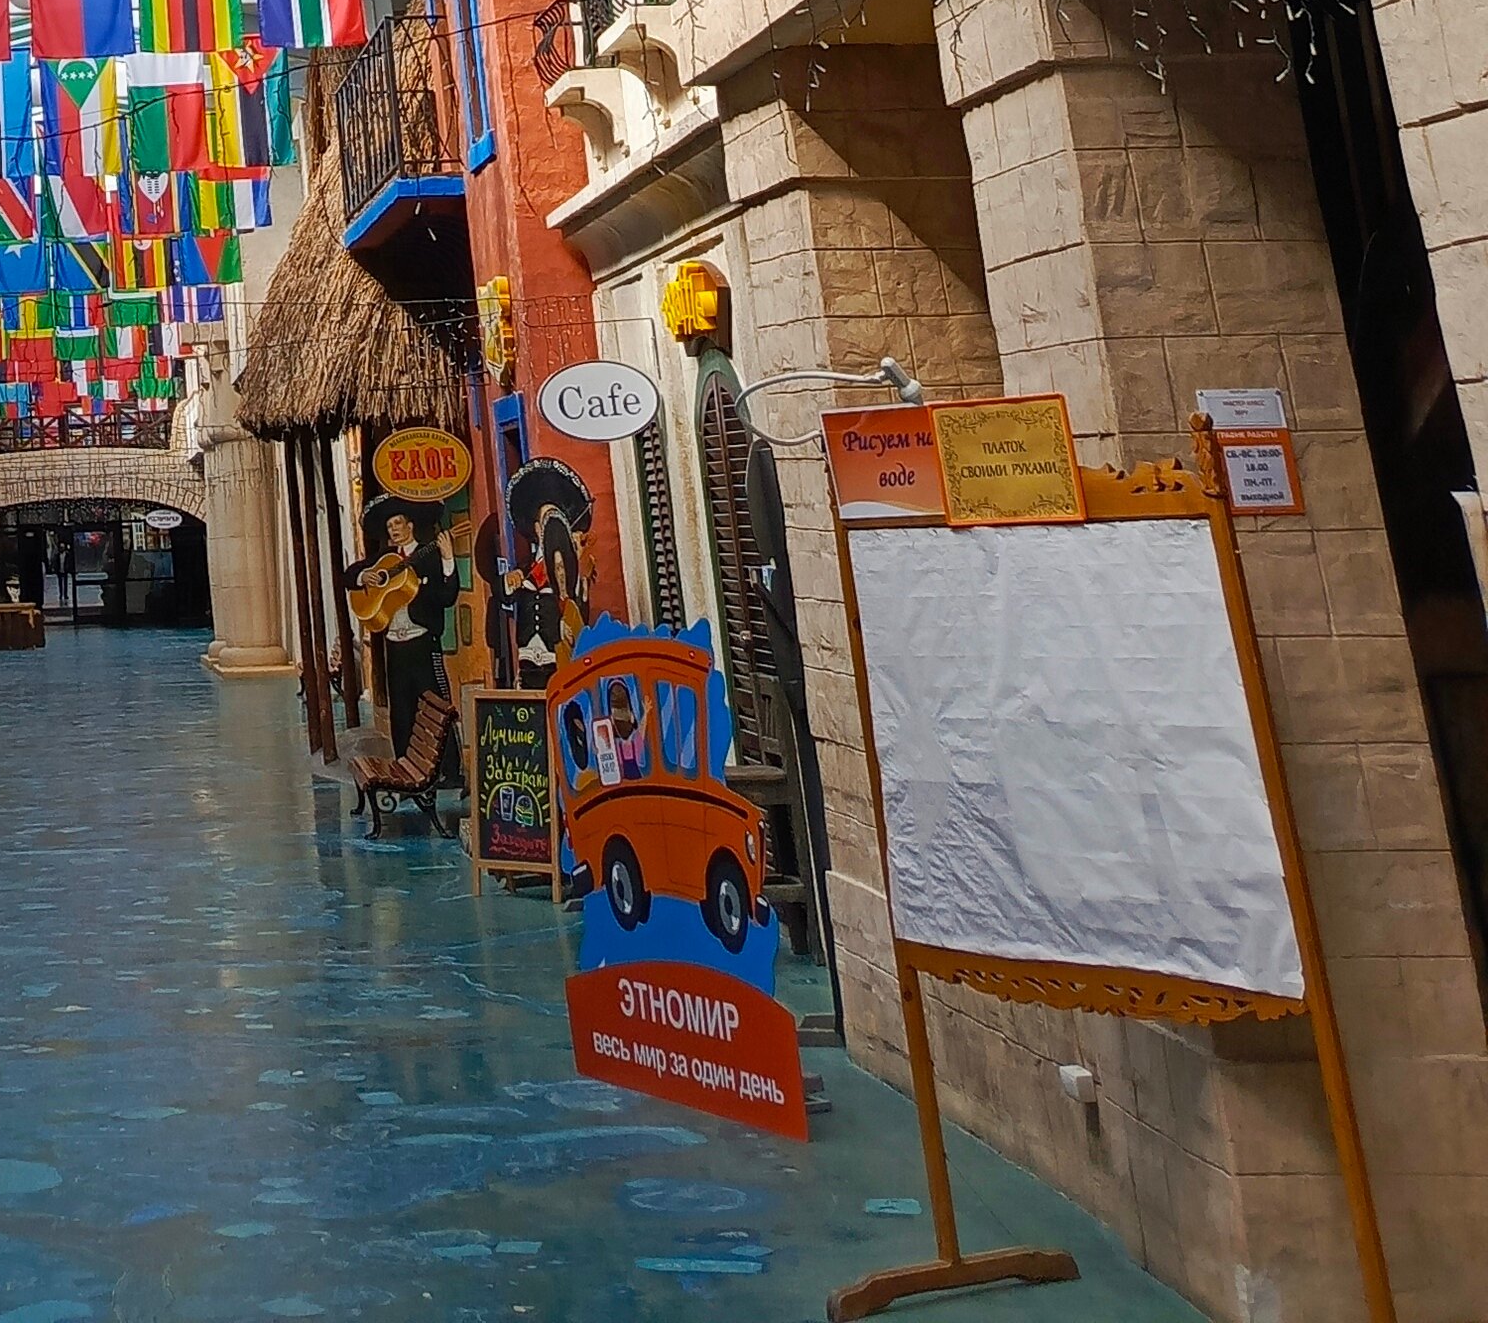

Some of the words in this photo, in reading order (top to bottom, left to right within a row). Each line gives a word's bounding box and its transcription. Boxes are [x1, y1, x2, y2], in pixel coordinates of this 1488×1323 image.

[558, 383, 642, 420] Cafe
[842, 431, 910, 458] Рисуем
[981, 439, 1027, 455] ПЛАТОК
[388, 446, 457, 481] КАФЕ
[879, 462, 916, 488] воде
[960, 464, 1009, 479] СВОИМИ
[1011, 461, 1058, 476] РУКАМИ
[480, 714, 536, 752] Лучшие
[618, 978, 740, 1042] ЭТНОМИР
[593, 1031, 631, 1062] весь
[633, 1041, 667, 1078] мир
[669, 1051, 689, 1078] за
[692, 1057, 736, 1091] один
[739, 1071, 785, 1106] день
